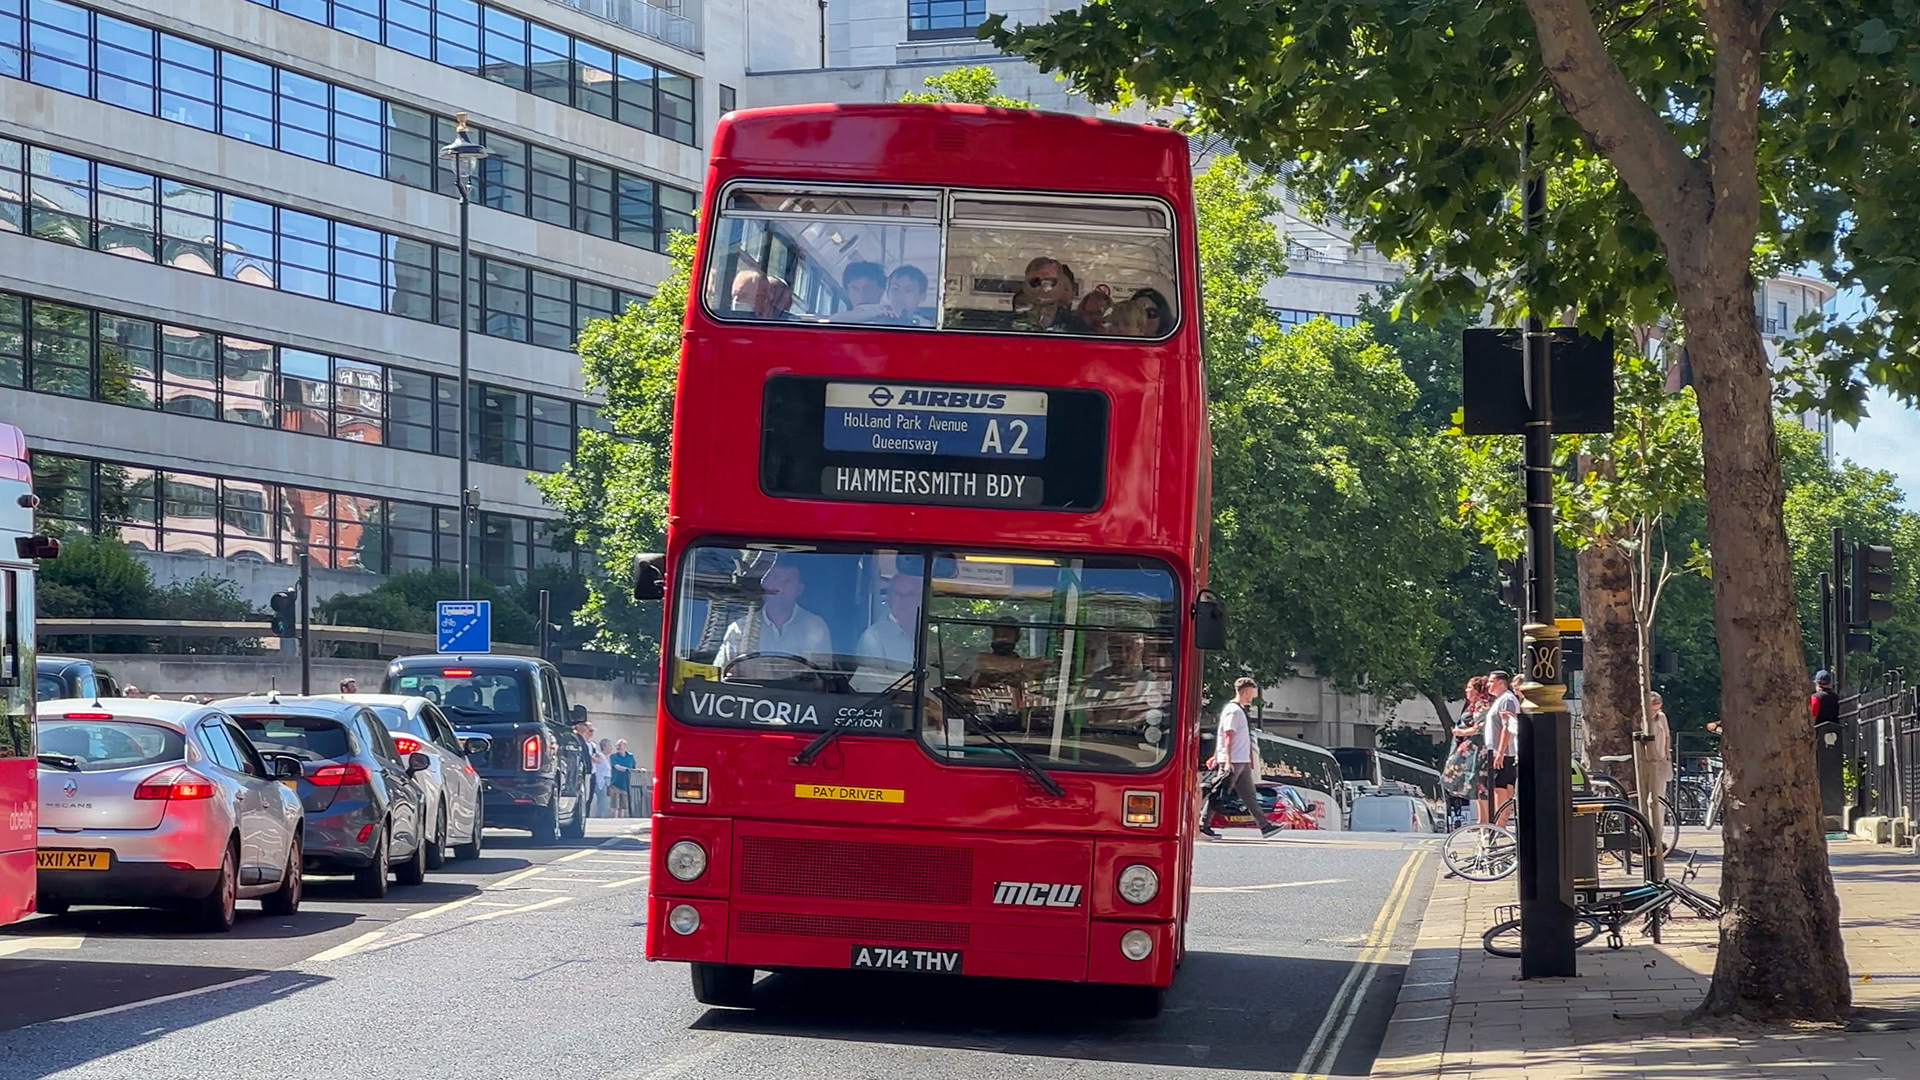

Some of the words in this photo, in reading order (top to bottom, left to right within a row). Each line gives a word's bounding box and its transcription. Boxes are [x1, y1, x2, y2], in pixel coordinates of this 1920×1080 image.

[898, 390, 1007, 409] AIRBUS
[843, 412, 892, 430] Holland
[896, 415, 922, 432] Park
[928, 418, 969, 433] Avenue
[872, 433, 939, 455] Queensway
[980, 418, 1030, 455] A2
[836, 467, 978, 497] HAMMERSMITH
[986, 475, 1026, 499] BDY
[690, 690, 819, 726] VICTORIA
[812, 786, 836, 799] PAY
[839, 788, 884, 801] DRIVER
[67, 853, 97, 868] XPV
[993, 881, 1082, 907] MCW
[855, 947, 909, 970] A714
[912, 950, 959, 972] THV
